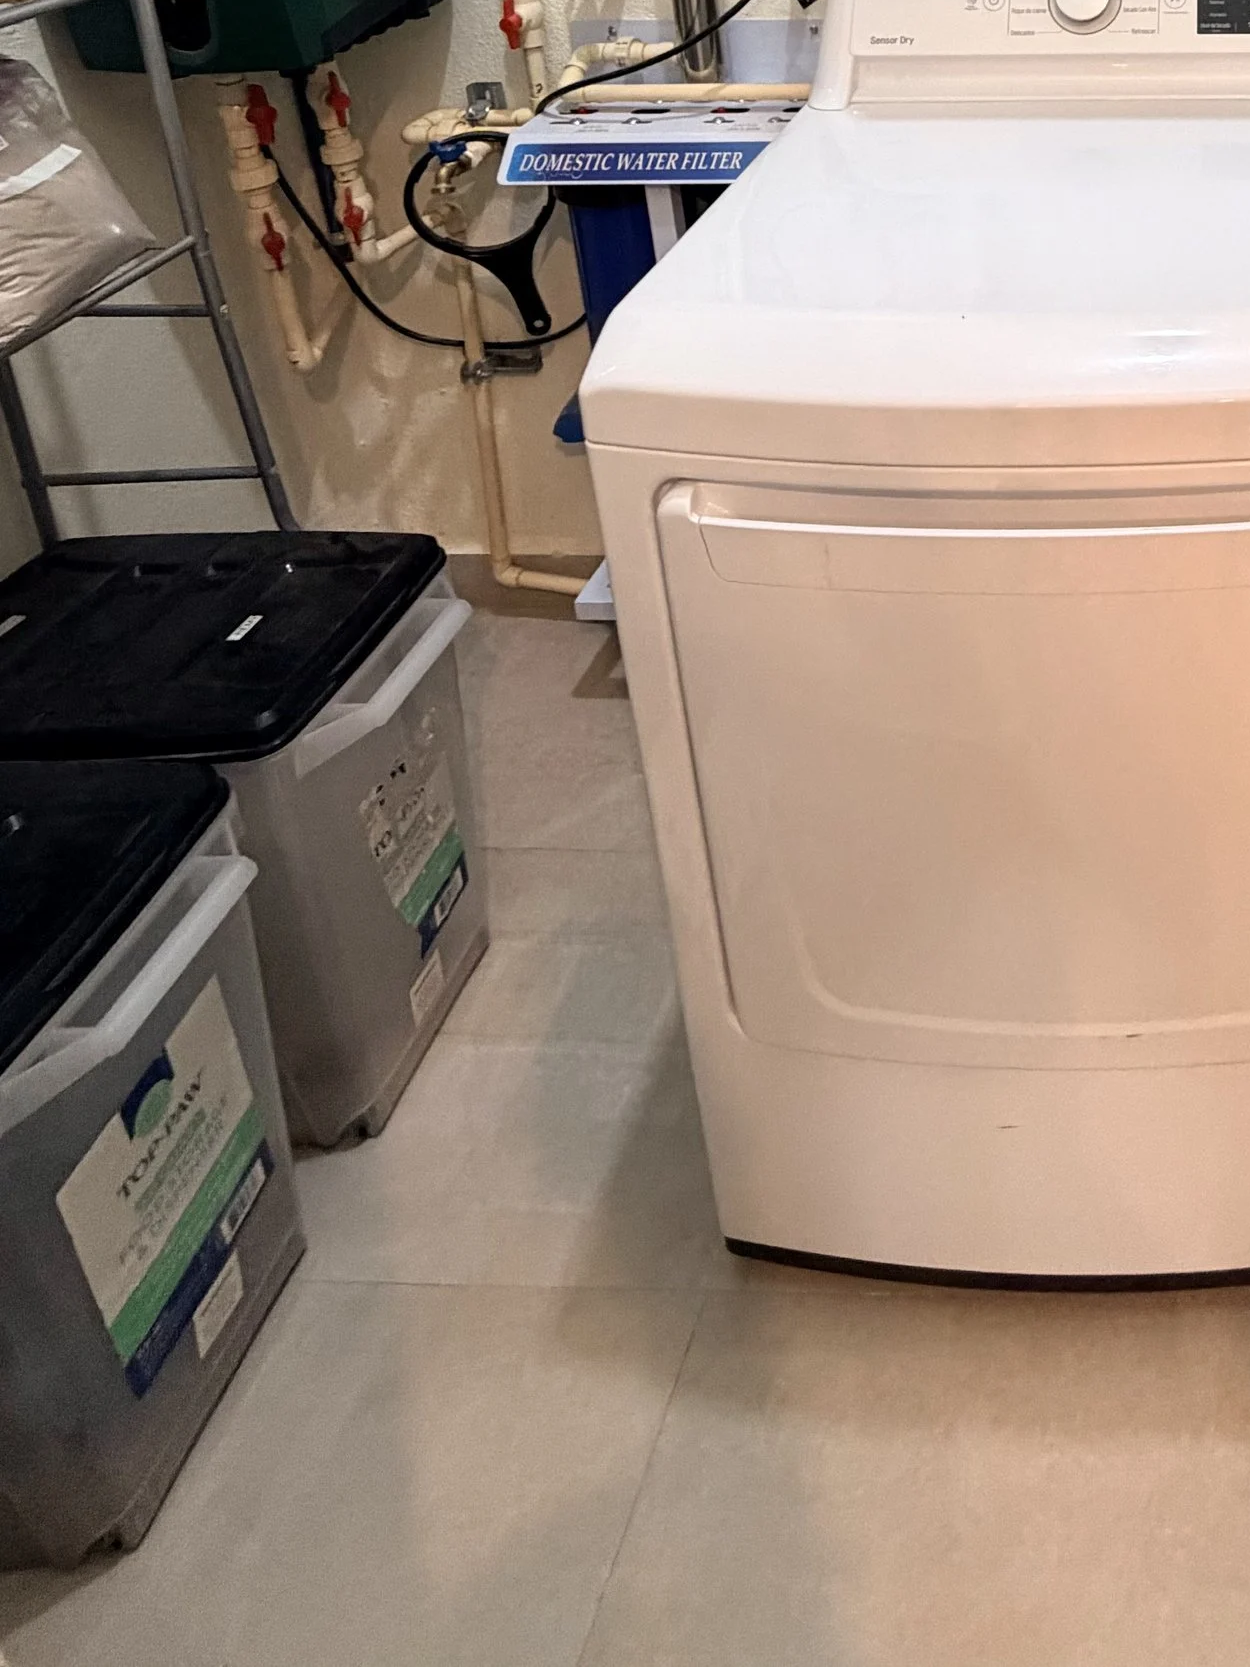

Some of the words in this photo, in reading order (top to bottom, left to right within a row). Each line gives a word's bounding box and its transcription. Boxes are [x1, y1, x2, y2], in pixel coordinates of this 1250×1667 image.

[870, 36, 898, 45] Sensor
[900, 36, 915, 46] Dry
[519, 152, 615, 172] DOMESTIC
[616, 151, 679, 171] WATER
[681, 150, 743, 170] FILTER
